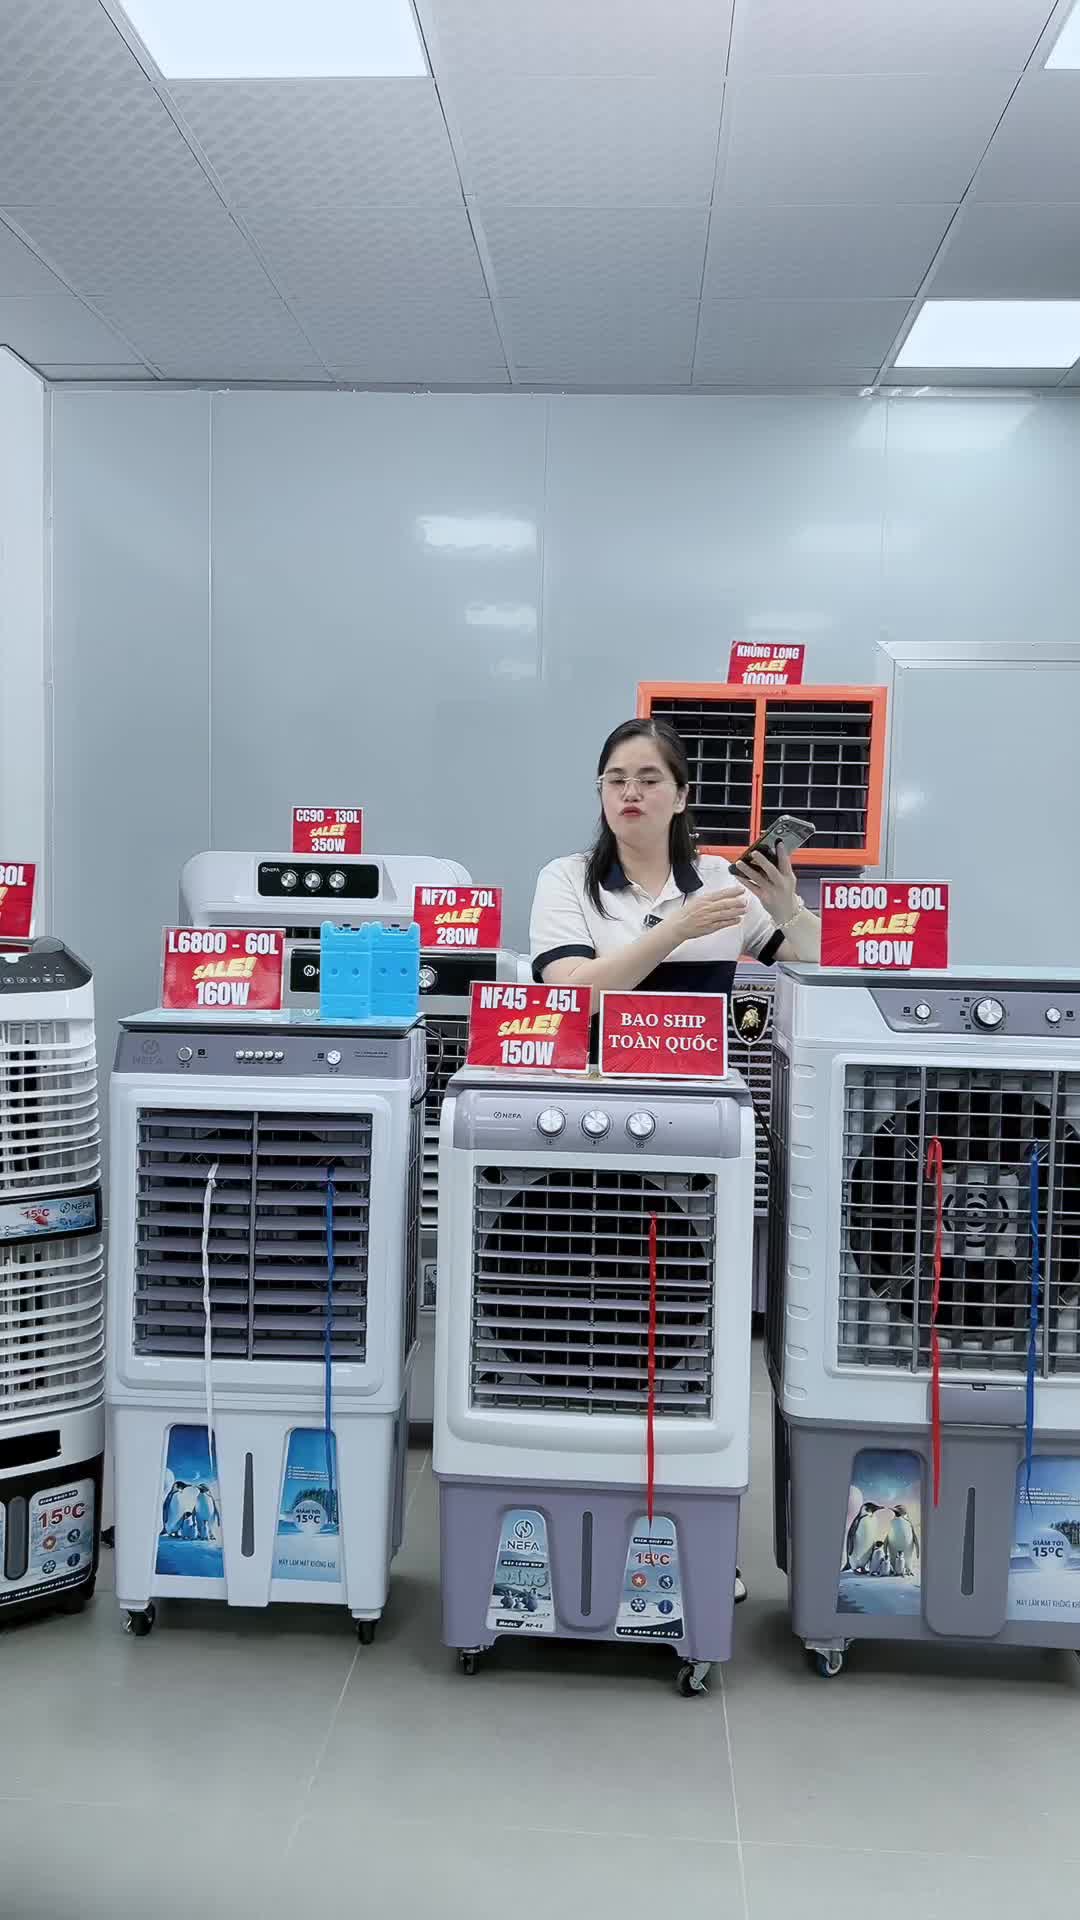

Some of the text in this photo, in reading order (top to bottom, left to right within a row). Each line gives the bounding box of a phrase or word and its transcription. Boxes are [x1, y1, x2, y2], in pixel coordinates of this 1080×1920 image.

[773, 647, 800, 659] LONG
[296, 809, 325, 822] CC90
[334, 810, 360, 823] 130L
[311, 838, 346, 852] 350W
[421, 888, 457, 906] NF70
[470, 890, 496, 907] 70L
[824, 886, 888, 910] L8600
[907, 886, 946, 911] 80L
[433, 907, 483, 925] SALE!
[850, 911, 921, 937] SALE!
[168, 931, 227, 954] L6800
[245, 932, 280, 955] 60L
[436, 927, 479, 945] 280W
[855, 939, 914, 966] 180W
[191, 956, 258, 981] SALE!
[195, 981, 250, 1006] 160W
[479, 986, 527, 1011] NF45
[545, 988, 581, 1013] 45L
[497, 1013, 564, 1037] SALE!
[621, 1012, 706, 1029] BAO SHIP
[499, 1040, 555, 1066] 150W
[608, 1031, 718, 1054] TOÀN QUỐC
[507, 1540, 539, 1551] NEFA
